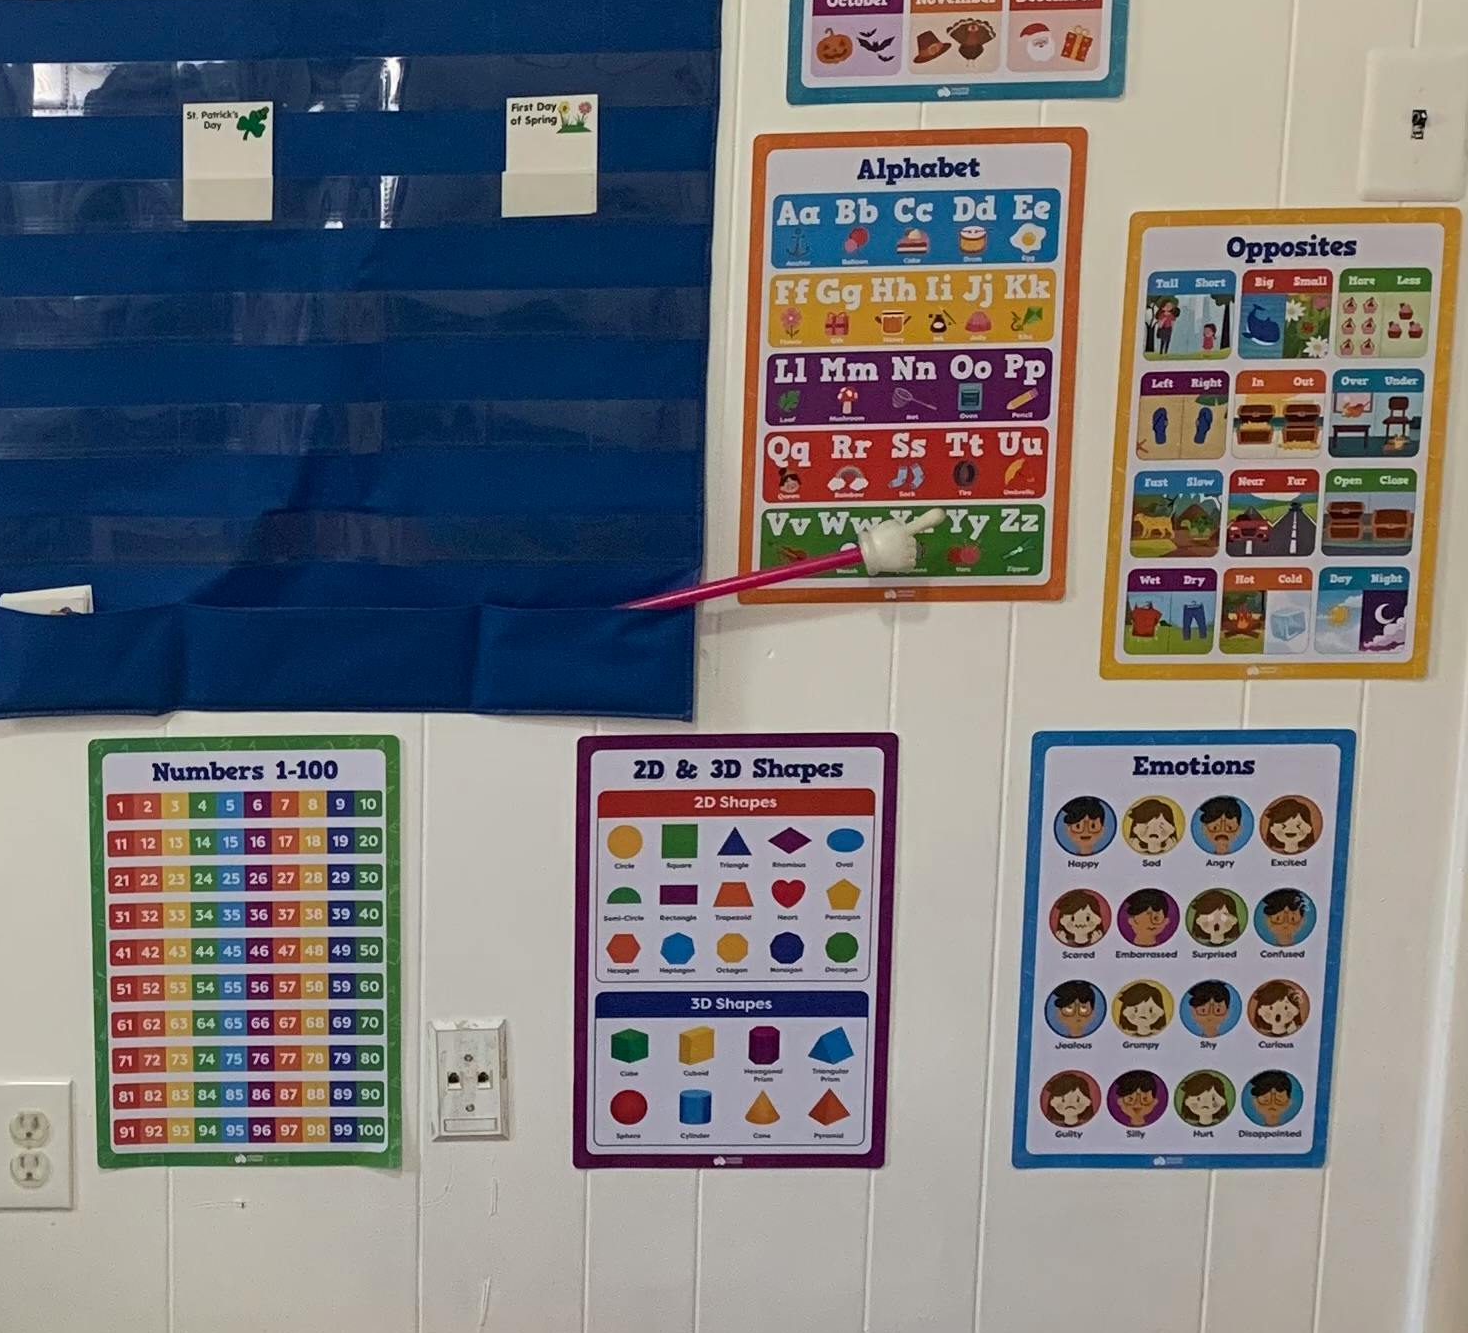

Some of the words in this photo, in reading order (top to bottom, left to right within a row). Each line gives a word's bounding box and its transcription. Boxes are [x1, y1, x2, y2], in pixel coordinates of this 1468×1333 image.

[187, 111, 198, 119] St.
[201, 110, 238, 119] Patrick's
[512, 103, 533, 112] First
[537, 103, 556, 112] Day
[204, 121, 221, 130] Day
[511, 116, 521, 125] of
[525, 115, 557, 127] Spring
[857, 157, 980, 185] Alphabet
[776, 201, 820, 226] Aa
[953, 196, 996, 221] Dd
[1227, 234, 1357, 263] Opposites
[1151, 377, 1173, 389] Left
[1191, 376, 1222, 390] Right
[152, 762, 264, 781] Numbers
[276, 760, 339, 780] 1-100
[633, 760, 664, 780] 2D
[676, 760, 697, 779] &
[710, 759, 741, 778] 3D
[753, 759, 844, 783] Shapes
[1133, 755, 1255, 776] Emotions
[1067, 860, 1099, 870] Happy
[1271, 858, 1307, 867] Excited
[1115, 950, 1178, 959] Embarrassed
[691, 997, 711, 1010] 3D
[716, 997, 772, 1012] Shapes
[358, 1124, 383, 1137] 100
